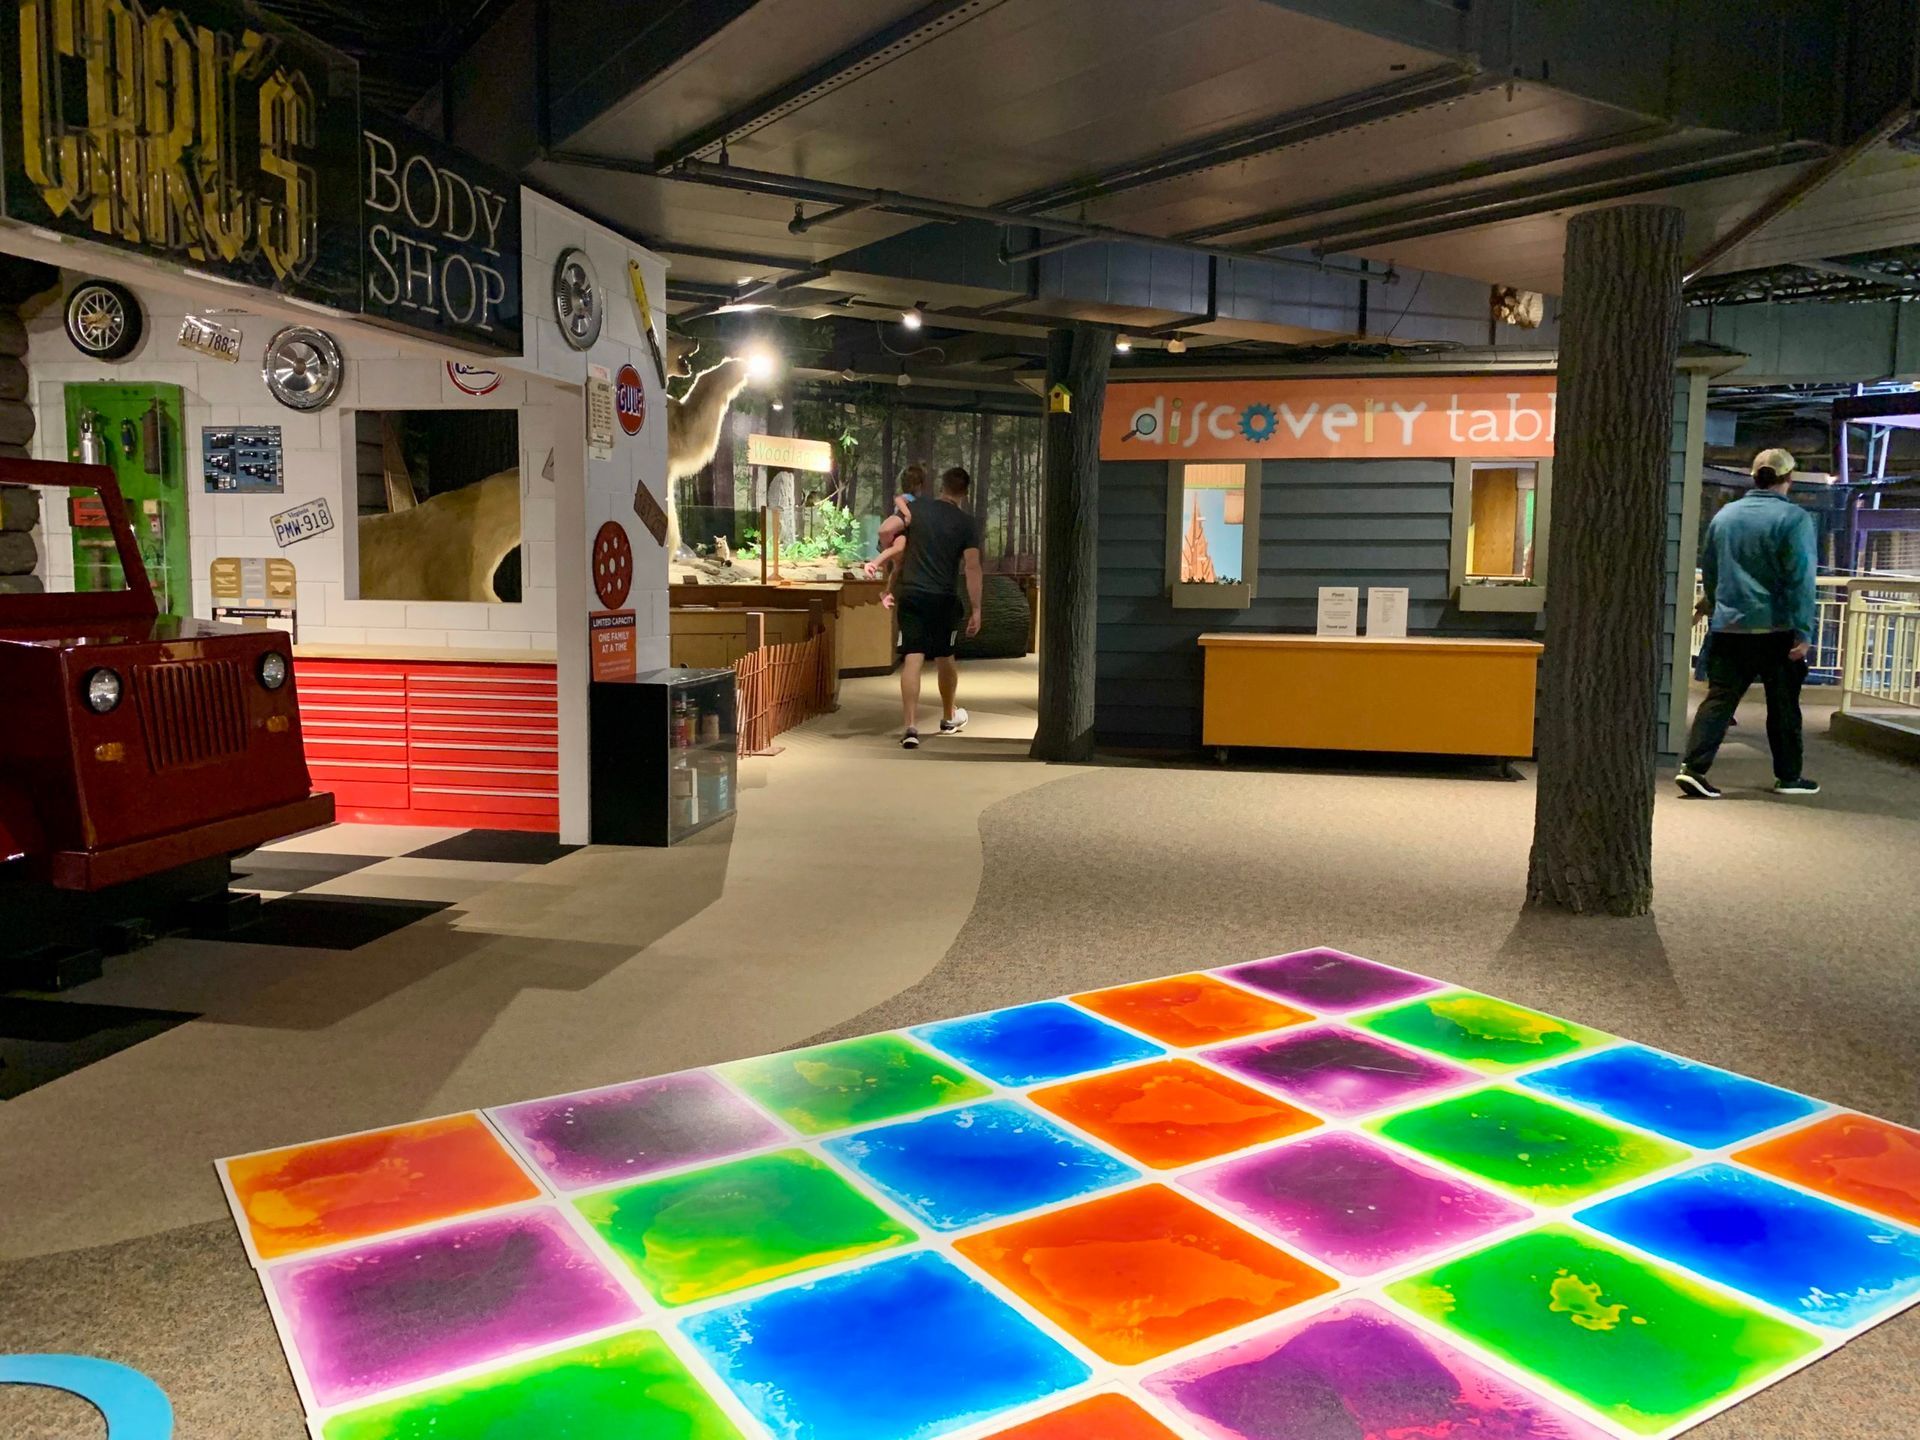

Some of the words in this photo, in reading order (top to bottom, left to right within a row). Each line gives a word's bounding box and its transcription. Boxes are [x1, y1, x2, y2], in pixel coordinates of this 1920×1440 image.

[363, 130, 507, 257] BODY
[369, 224, 505, 332] SHOP
[207, 332, 236, 356] 7882
[618, 382, 644, 417] GULF
[1126, 395, 1428, 448] discovery
[1446, 393, 1556, 443] tabl
[276, 509, 329, 542] PMW-918
[593, 617, 611, 627] LIMITED
[612, 616, 634, 626] CAPACITY
[598, 632, 610, 642] ONE
[611, 631, 629, 641] FAMILY
[602, 644, 609, 653] AT
[615, 641, 627, 651] TIME
